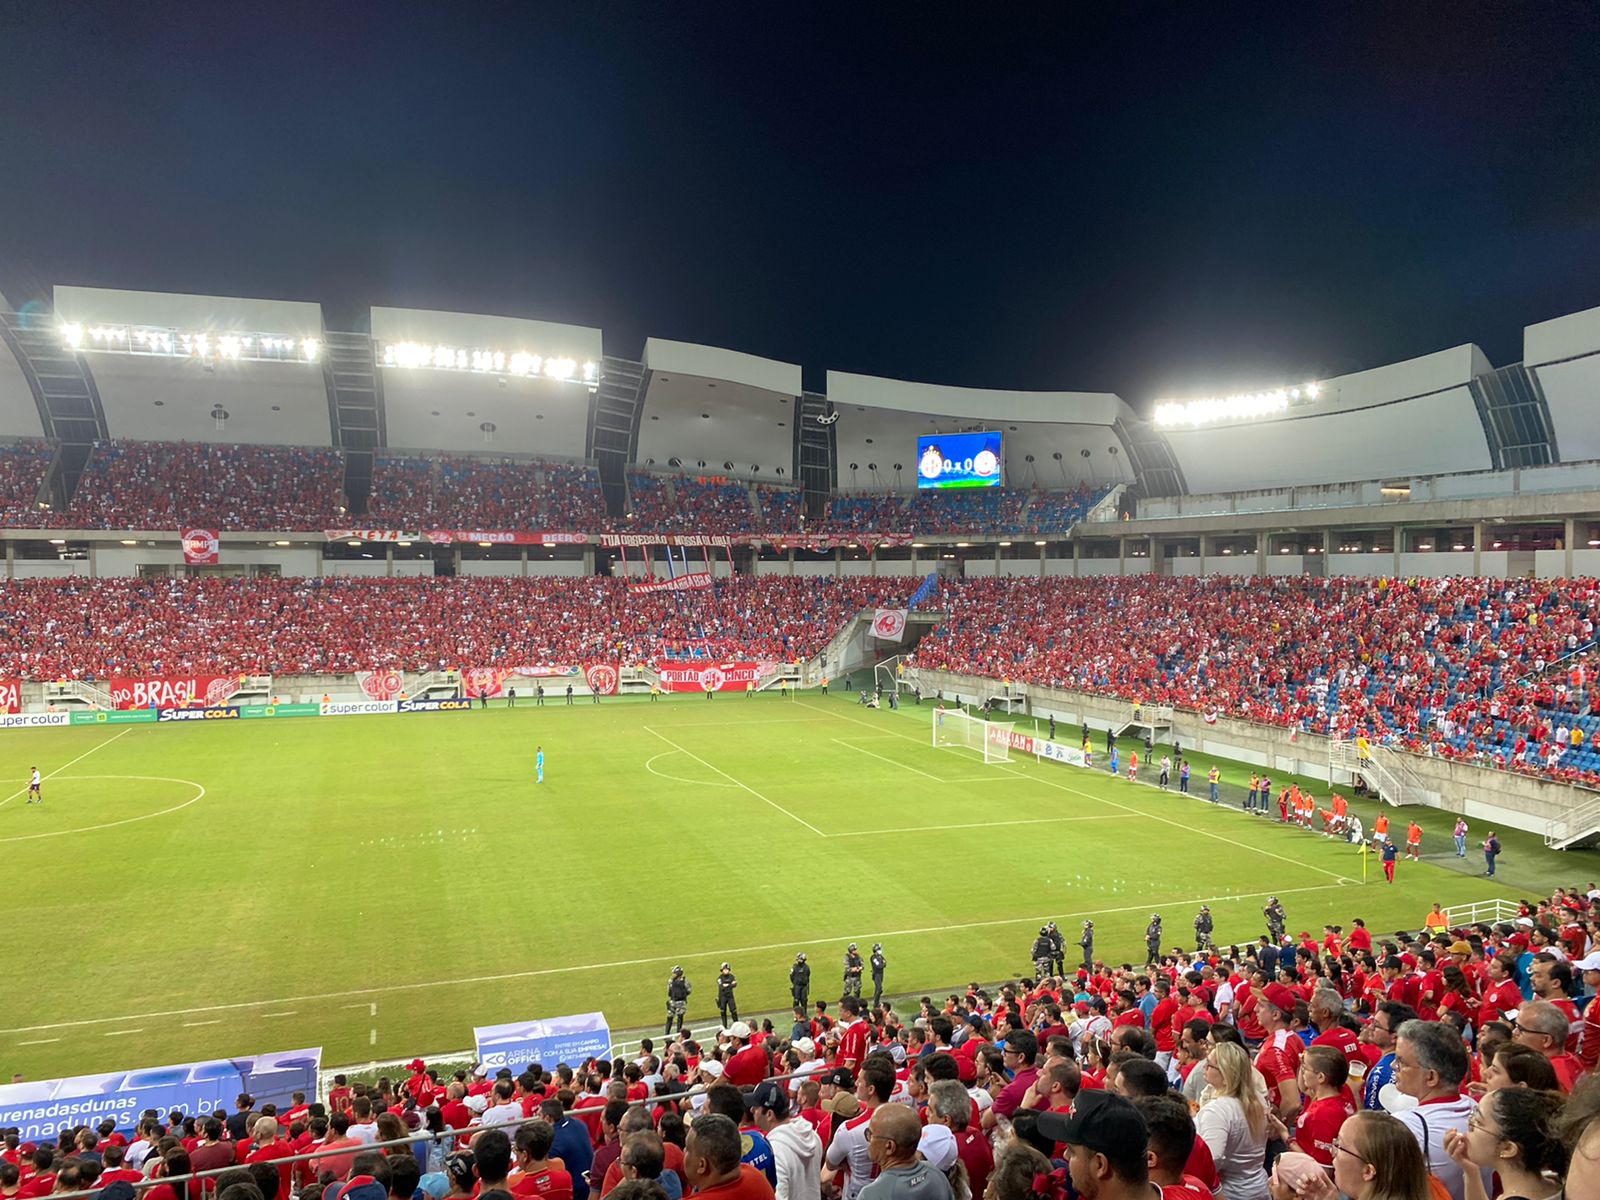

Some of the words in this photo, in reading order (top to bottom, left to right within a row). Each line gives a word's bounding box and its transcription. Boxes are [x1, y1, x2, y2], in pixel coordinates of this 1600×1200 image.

[666, 669, 699, 681] PORTÃO
[725, 669, 754, 680] CINCO
[133, 680, 204, 706] BRASIL
[330, 704, 363, 715] super
[364, 702, 394, 711] color
[401, 700, 439, 712] SUPER
[440, 701, 469, 709] COLA
[31, 714, 65, 724] color
[159, 708, 204, 721] SUPER
[205, 709, 238, 718] COLA
[508, 1047, 541, 1058] ARENA
[508, 1054, 542, 1065] OFFICE
